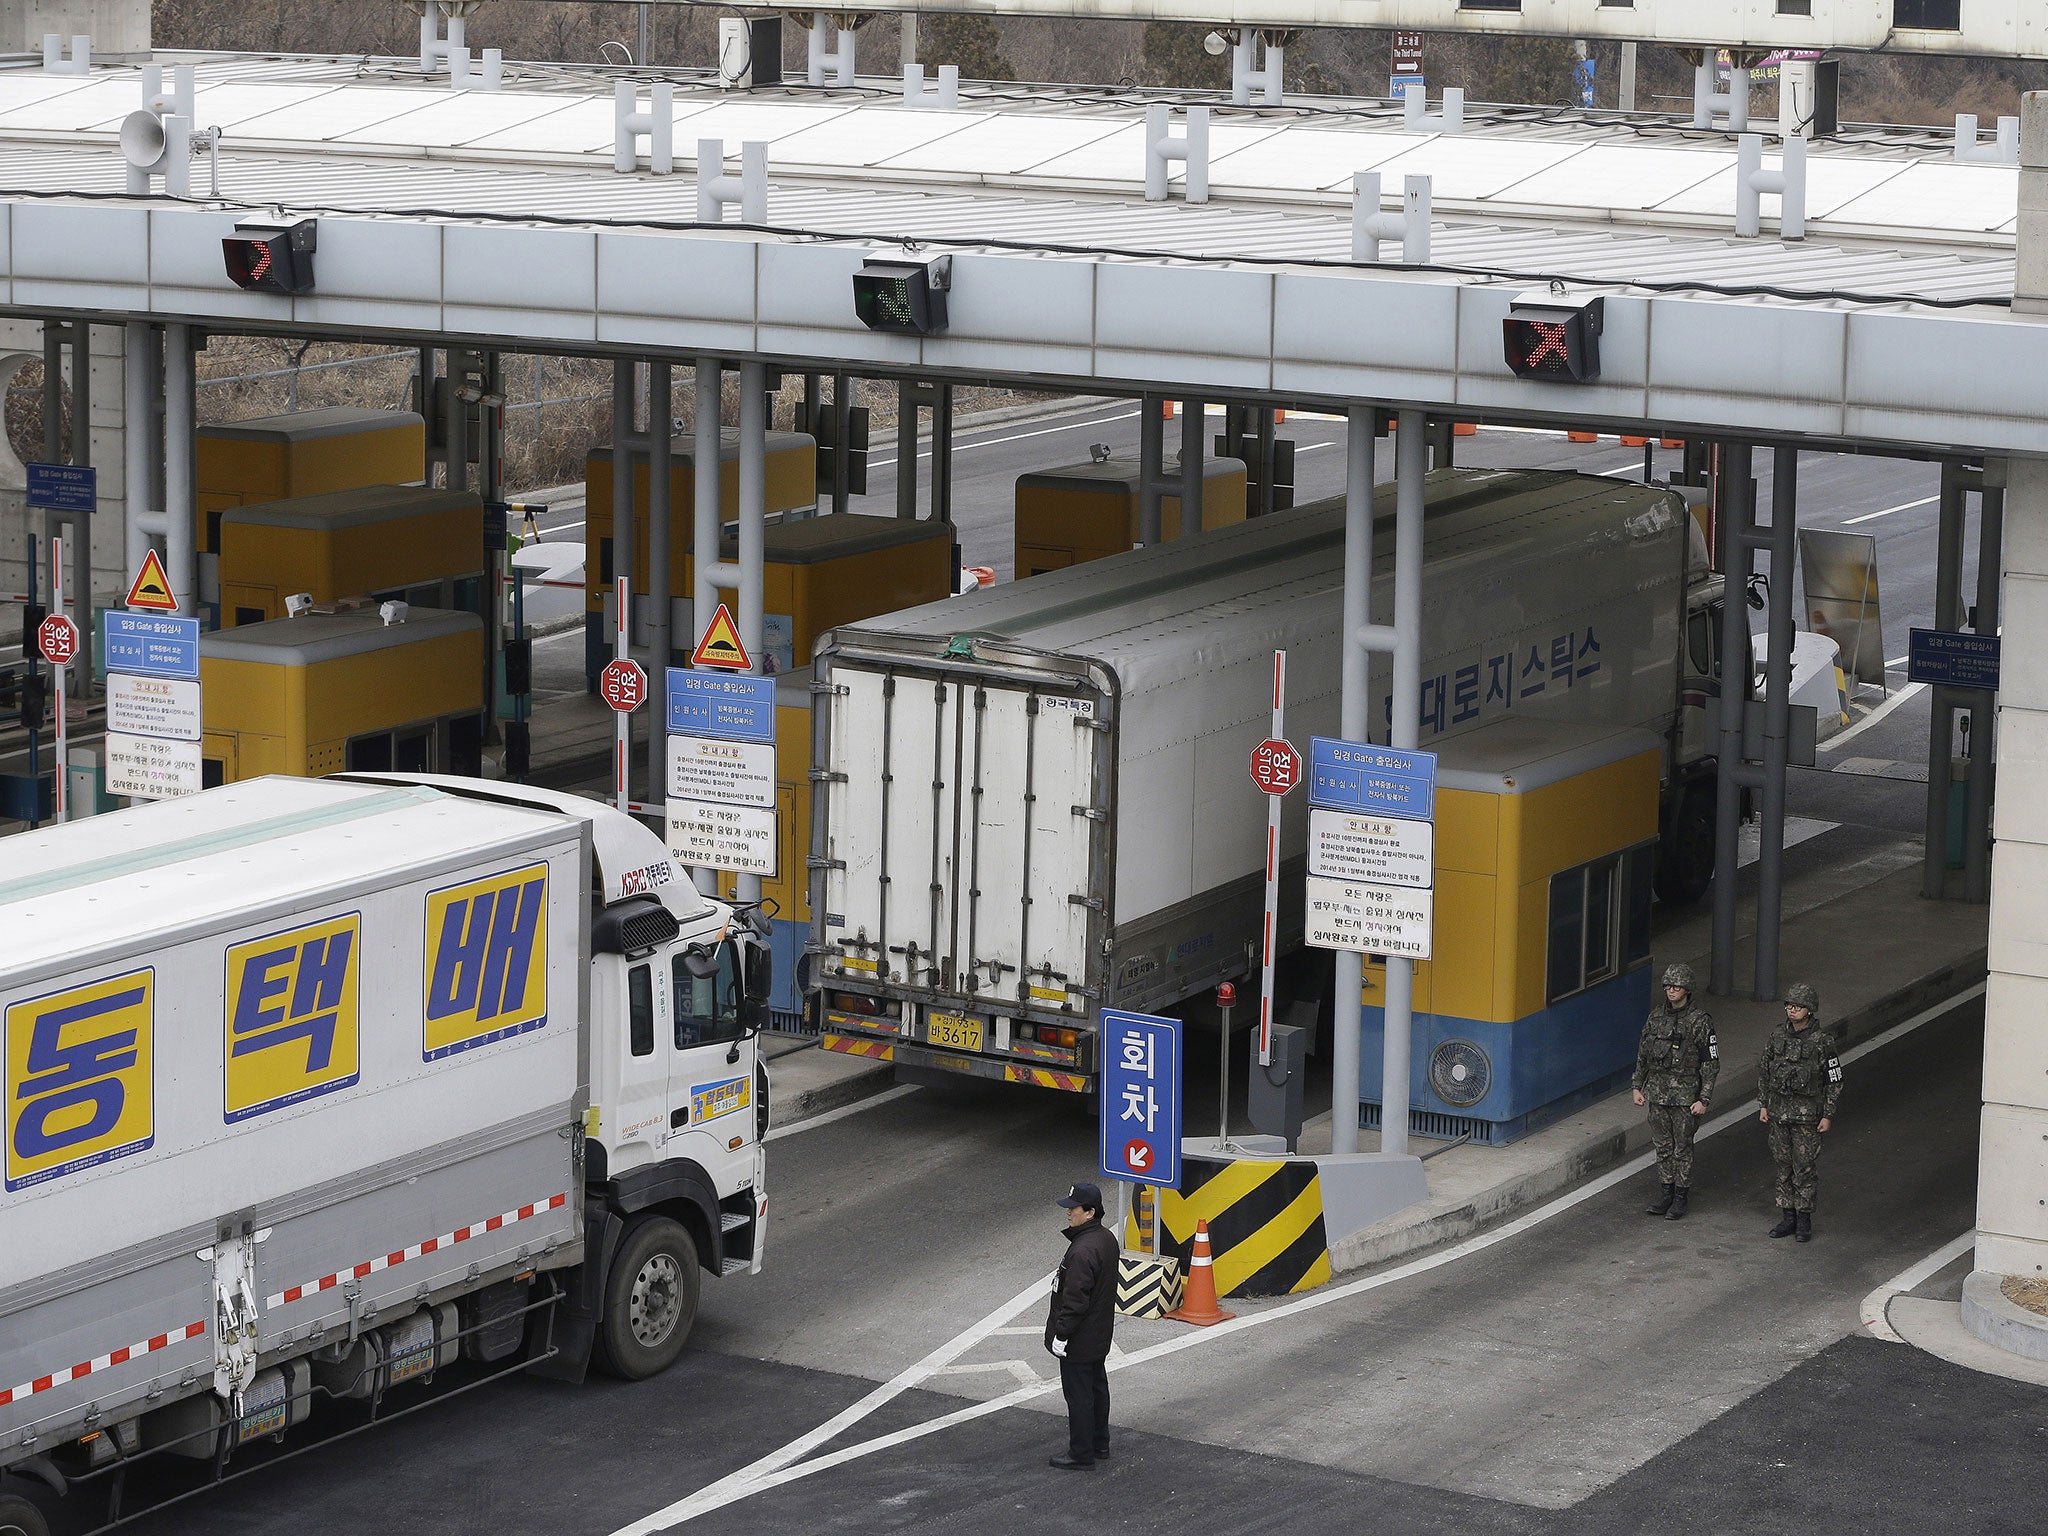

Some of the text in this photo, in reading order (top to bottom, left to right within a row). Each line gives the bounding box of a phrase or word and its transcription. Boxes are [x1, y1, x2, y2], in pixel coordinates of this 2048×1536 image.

[121, 620, 182, 634] 입경 Gate 출입심사
[44, 623, 55, 656] STOP
[56, 625, 70, 657] 정지
[1945, 639, 1961, 648] Gate
[608, 667, 620, 702] STOP
[620, 670, 637, 704] 정지
[685, 678, 754, 695] 입경 Gate 출입심사
[674, 705, 707, 716] 인원심사
[702, 745, 739, 756] 안내사항
[1258, 748, 1272, 784] STOP
[1333, 749, 1412, 770] 입경 Gate 출입심사
[1272, 751, 1291, 787] 정지
[1318, 777, 1357, 790] 인원심사
[699, 809, 714, 818] 모든
[1350, 821, 1392, 834] 안내사항
[691, 837, 714, 847] 반드시
[1345, 888, 1362, 899] 모든
[1335, 917, 1362, 929] 반드시
[1120, 1030, 1159, 1132] 회차
